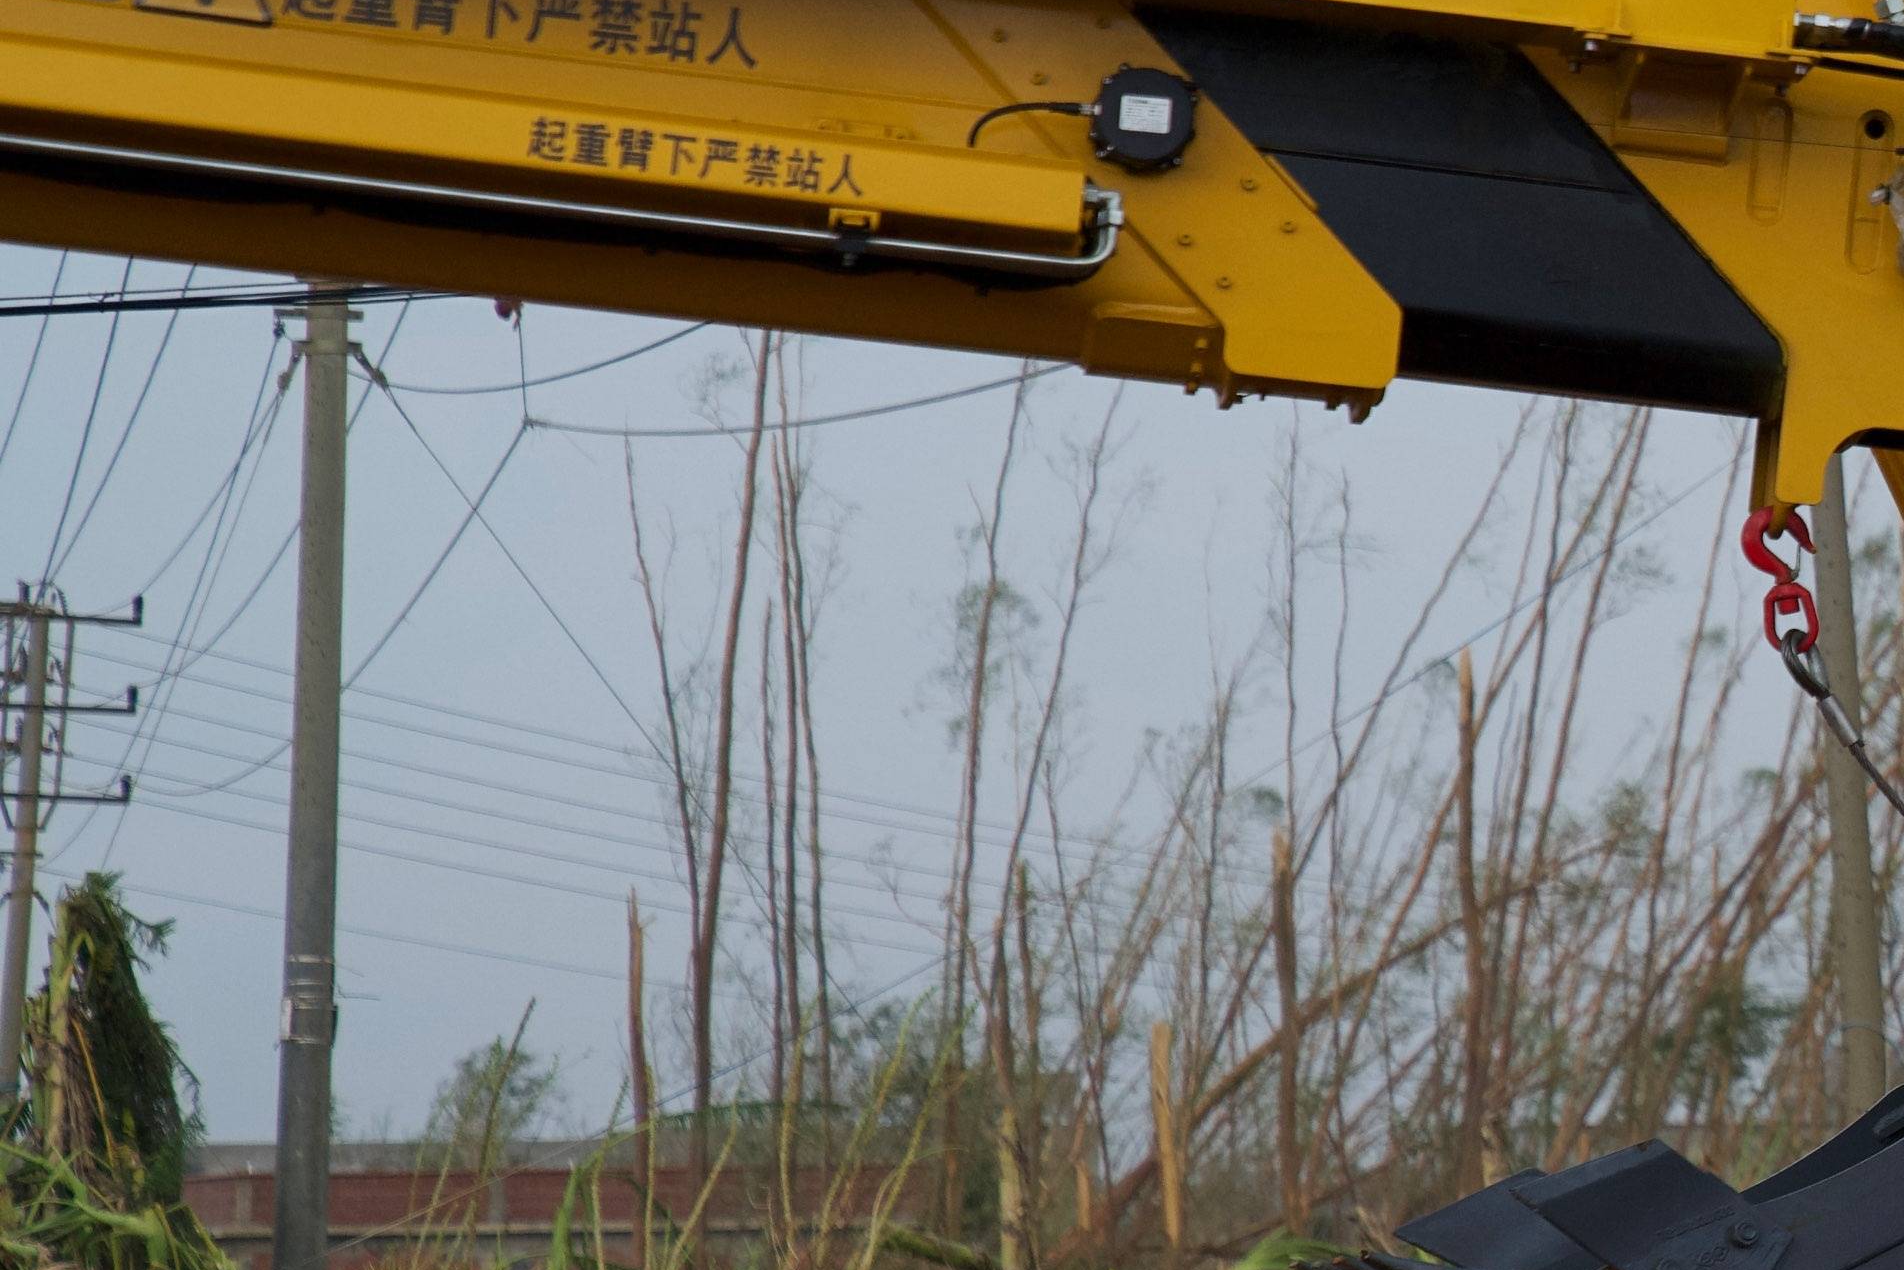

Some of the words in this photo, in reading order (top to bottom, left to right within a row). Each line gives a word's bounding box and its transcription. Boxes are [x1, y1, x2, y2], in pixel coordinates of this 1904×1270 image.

[527, 116, 864, 197] 起重臂下严禁站人
